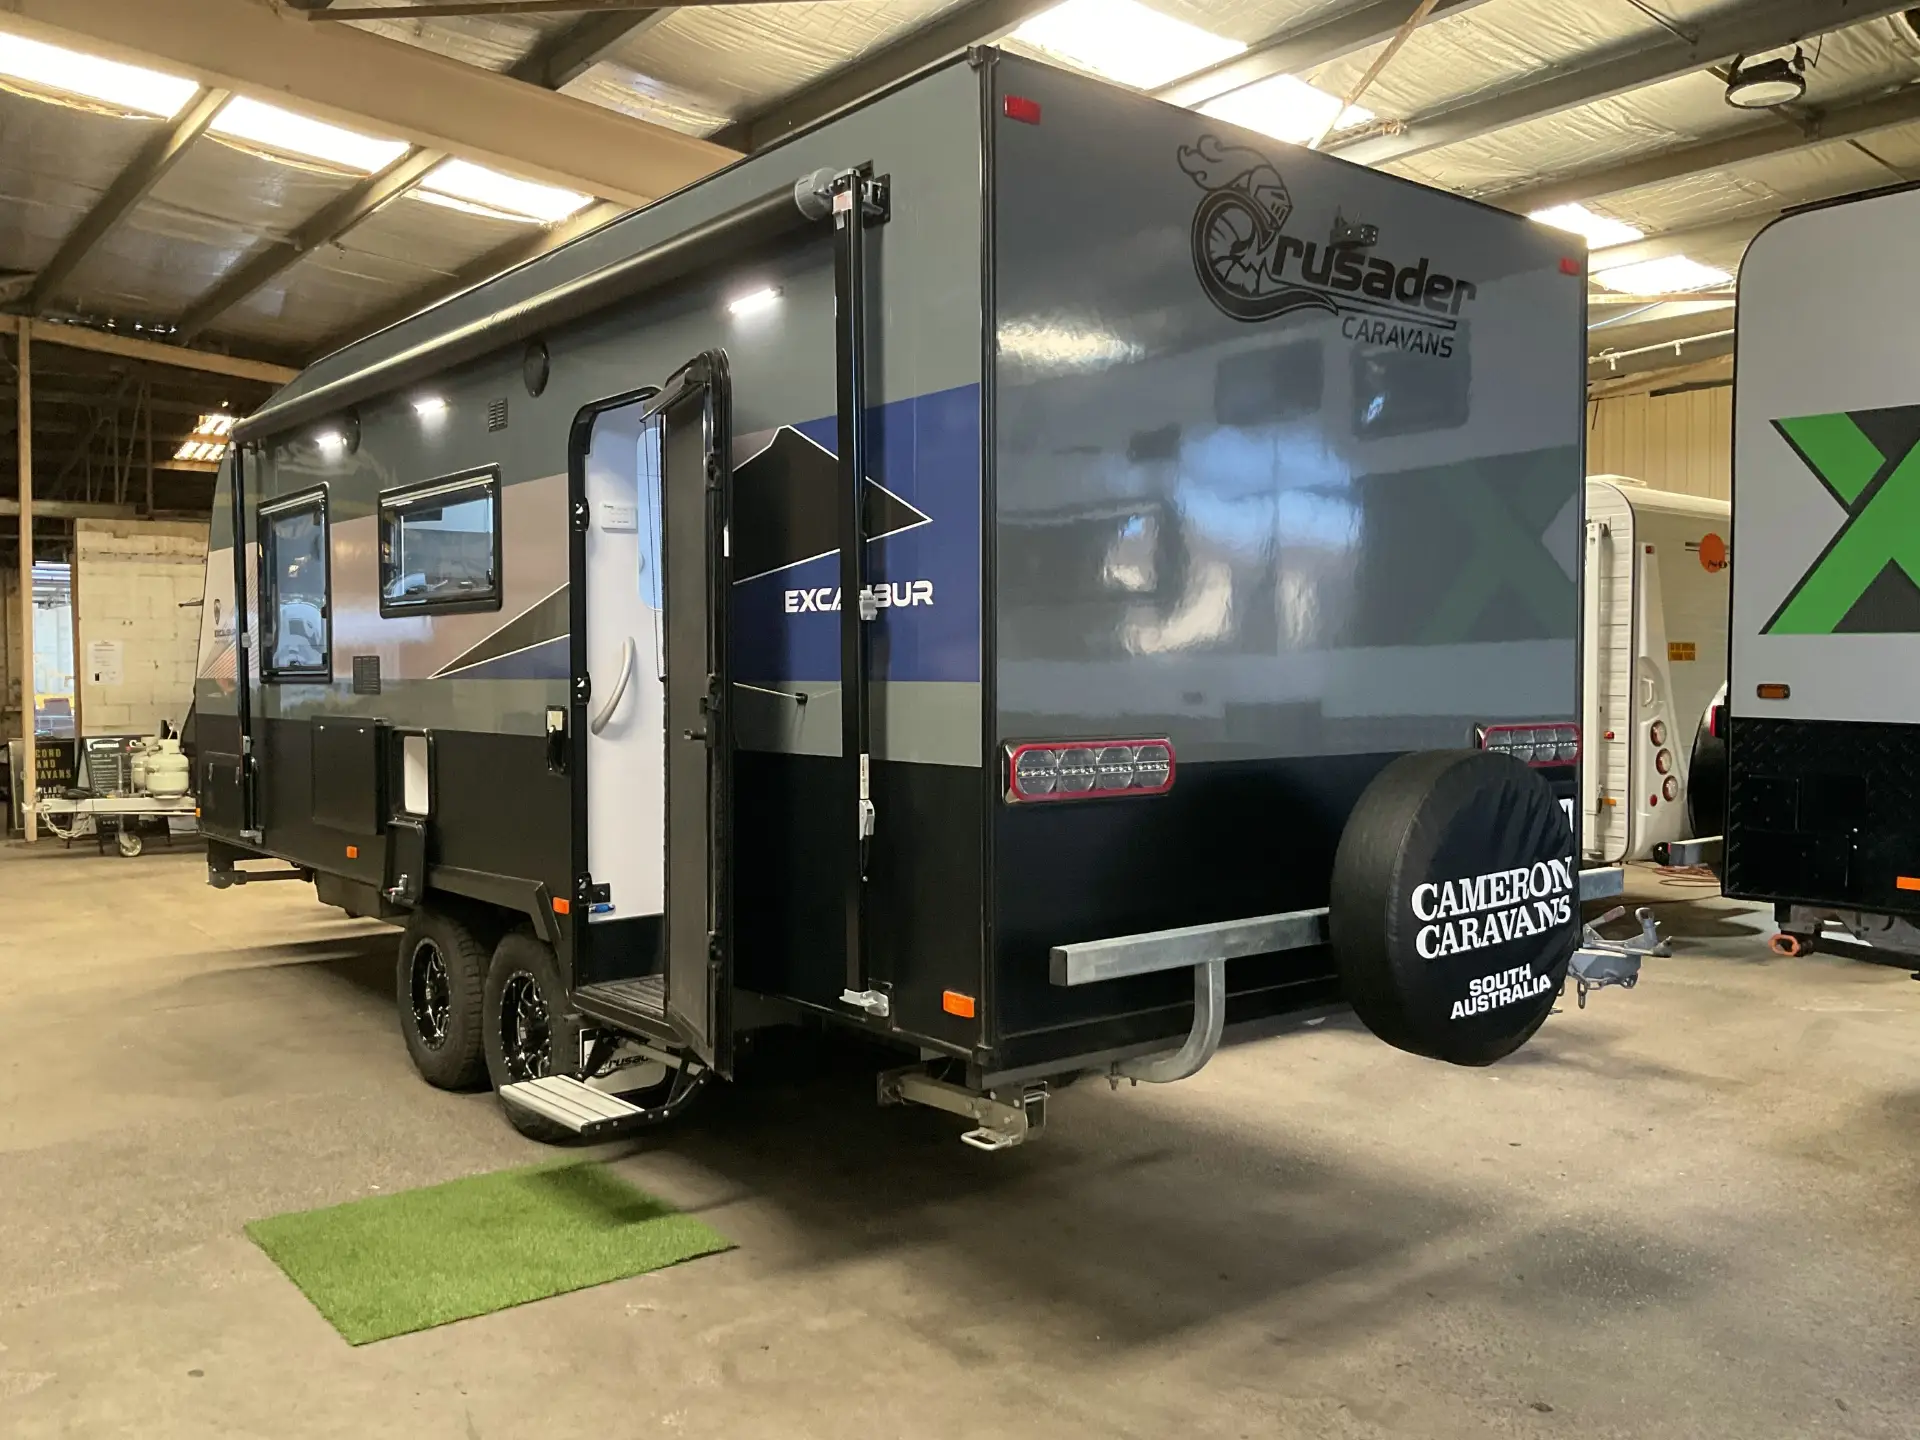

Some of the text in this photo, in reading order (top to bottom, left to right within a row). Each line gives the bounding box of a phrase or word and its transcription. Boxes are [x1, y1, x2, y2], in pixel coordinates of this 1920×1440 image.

[1342, 316, 1454, 358] CARAVANS
[784, 580, 934, 613] EXCBUR
[1411, 856, 1573, 921] CAMERON
[1415, 895, 1572, 959] CARAVANS
[1450, 974, 1552, 1019] AUSTRALIA
[1469, 963, 1532, 997] SOUTH
